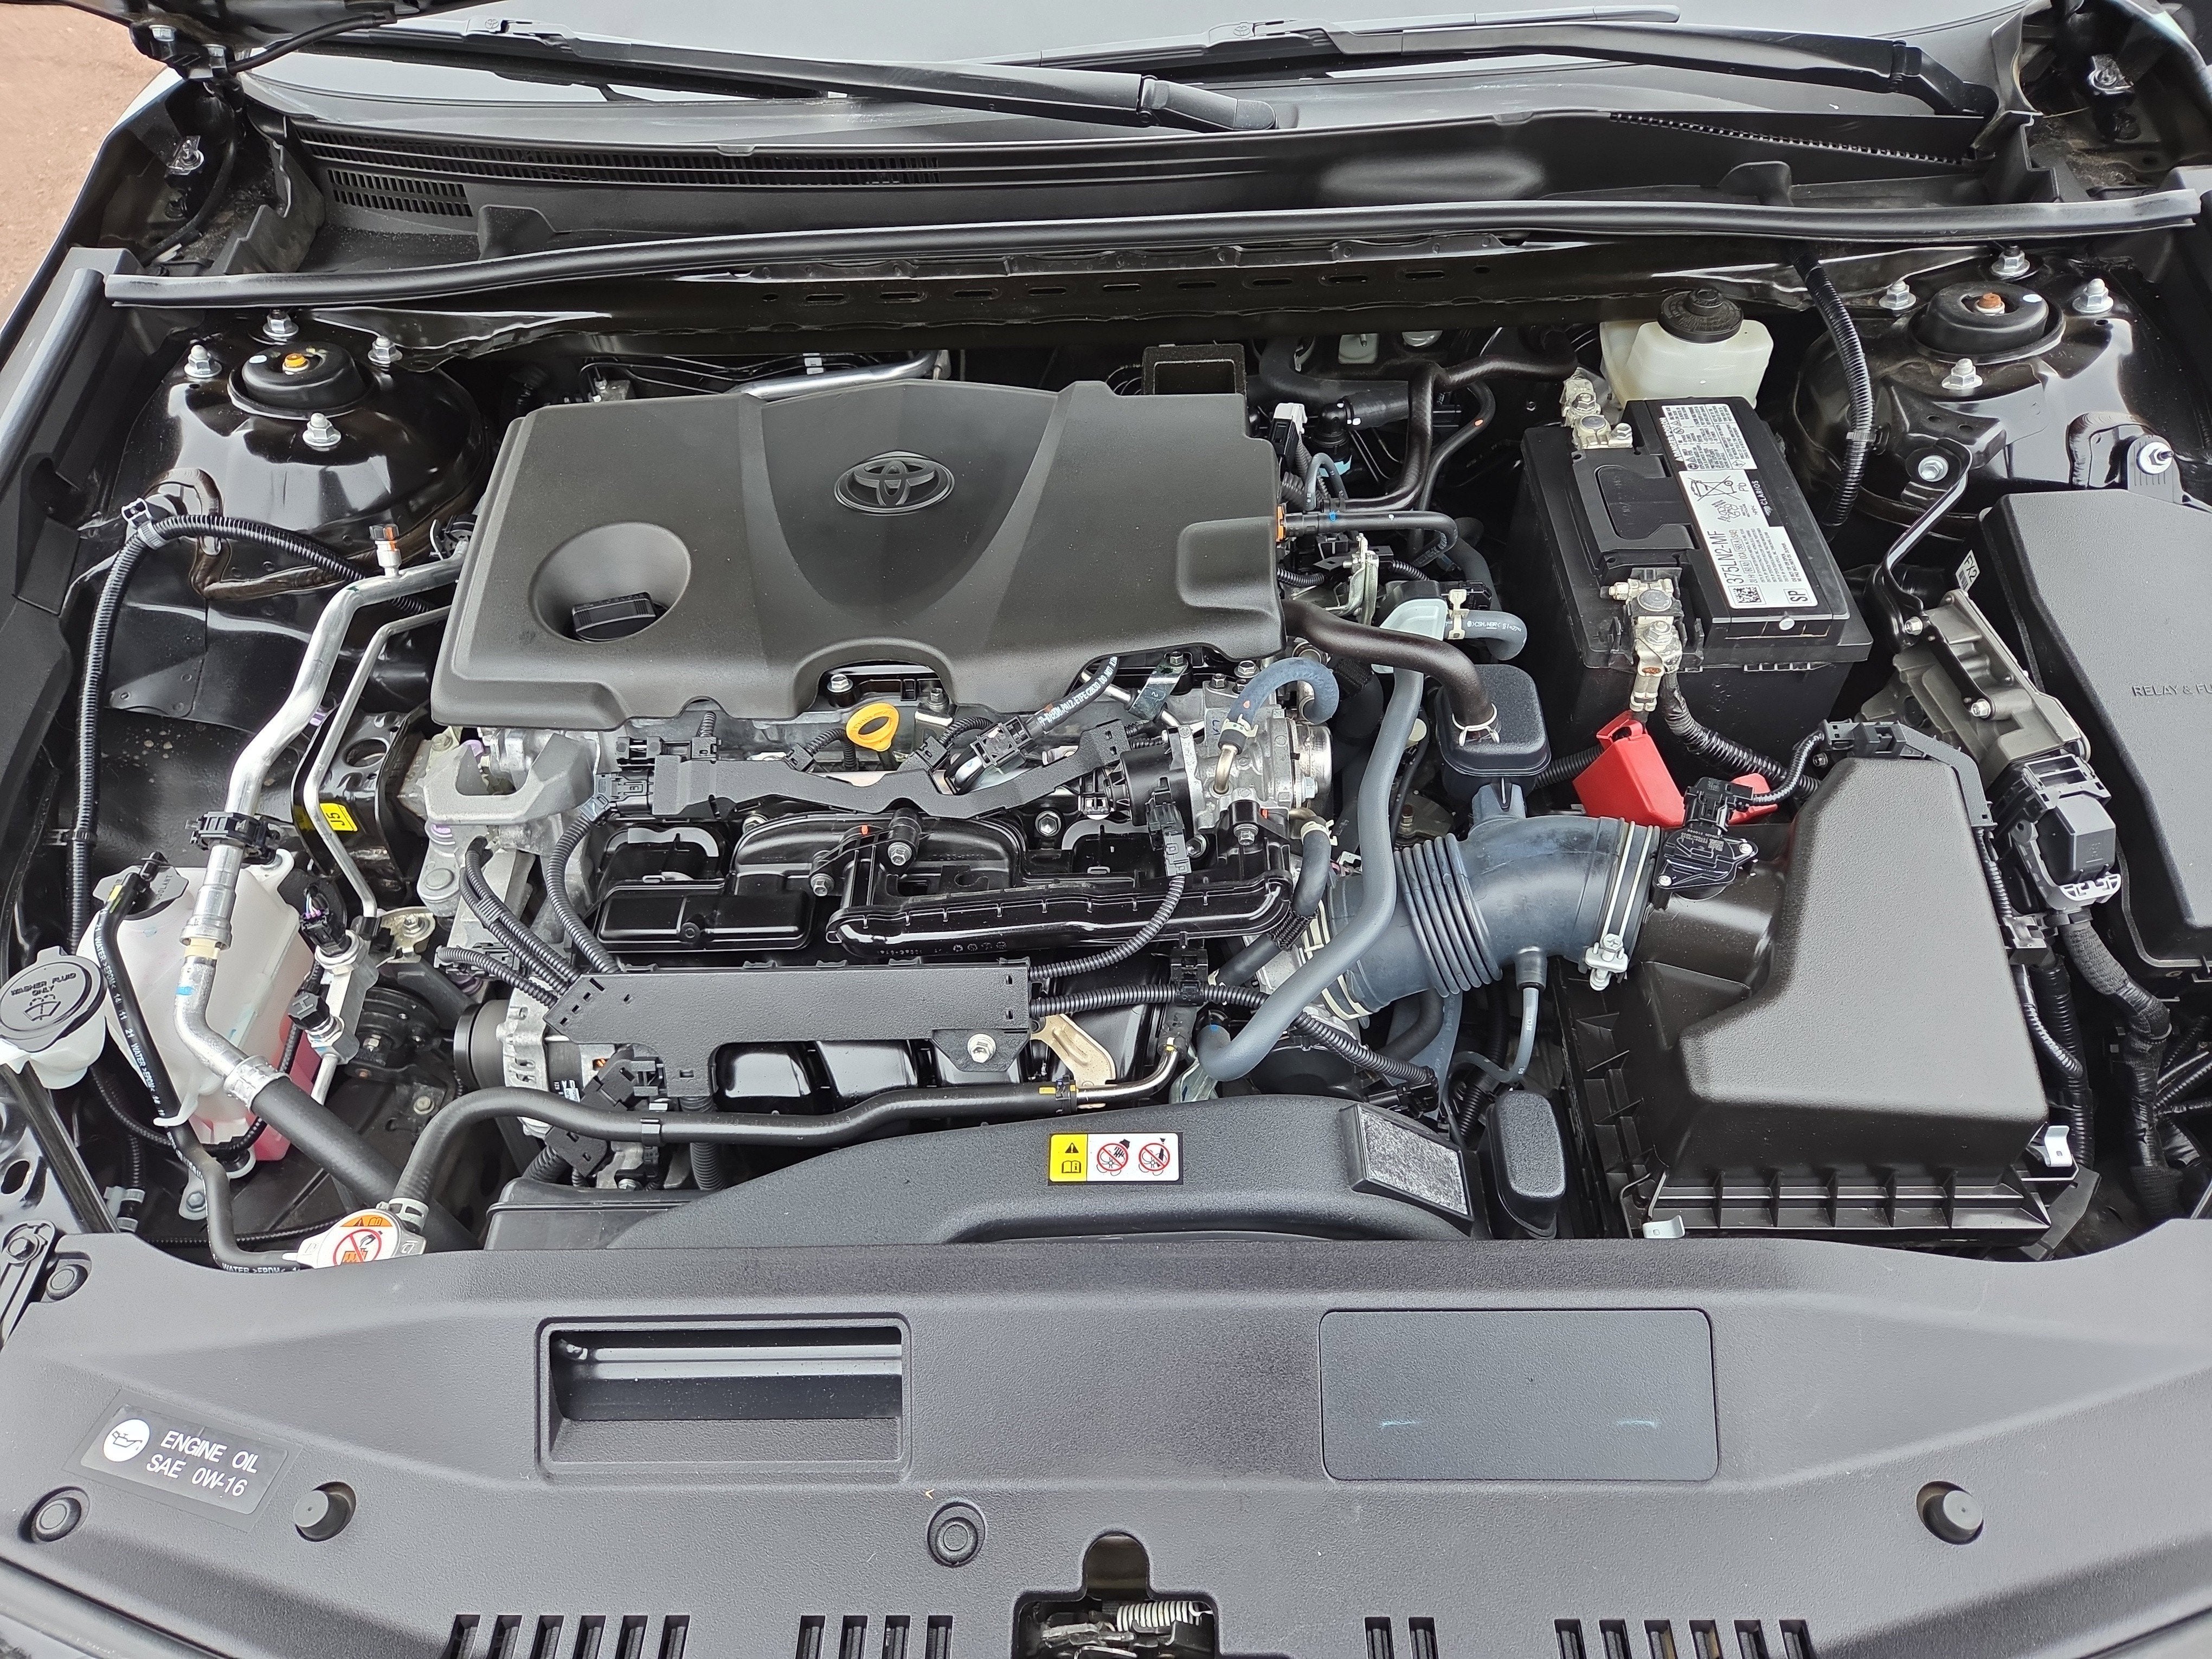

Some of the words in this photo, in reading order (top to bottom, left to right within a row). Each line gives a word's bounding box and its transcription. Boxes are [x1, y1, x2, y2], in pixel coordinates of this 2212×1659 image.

[1737, 483, 1749, 491] Pb
[1751, 480, 1768, 505] CLARIOS
[1707, 531, 1744, 583] 375LN2-MF
[1964, 555, 1977, 582] FX2
[1787, 590, 1808, 602] SP
[2132, 685, 2178, 696] RELAY
[2183, 685, 2193, 695] &
[325, 813, 345, 826] J5
[11, 981, 47, 995] WASHER
[52, 973, 76, 983] FLUID
[32, 985, 54, 996] ONLY
[95, 936, 106, 962] WATER
[125, 1028, 136, 1038] 21
[131, 1043, 146, 1067] WATER
[292, 994, 314, 1014] H
[222, 1262, 250, 1274] WATER
[160, 1430, 227, 1463] ENGINE
[232, 1451, 259, 1474] OIL
[146, 1454, 187, 1478] SAE
[191, 1467, 248, 1497] 0W-16
